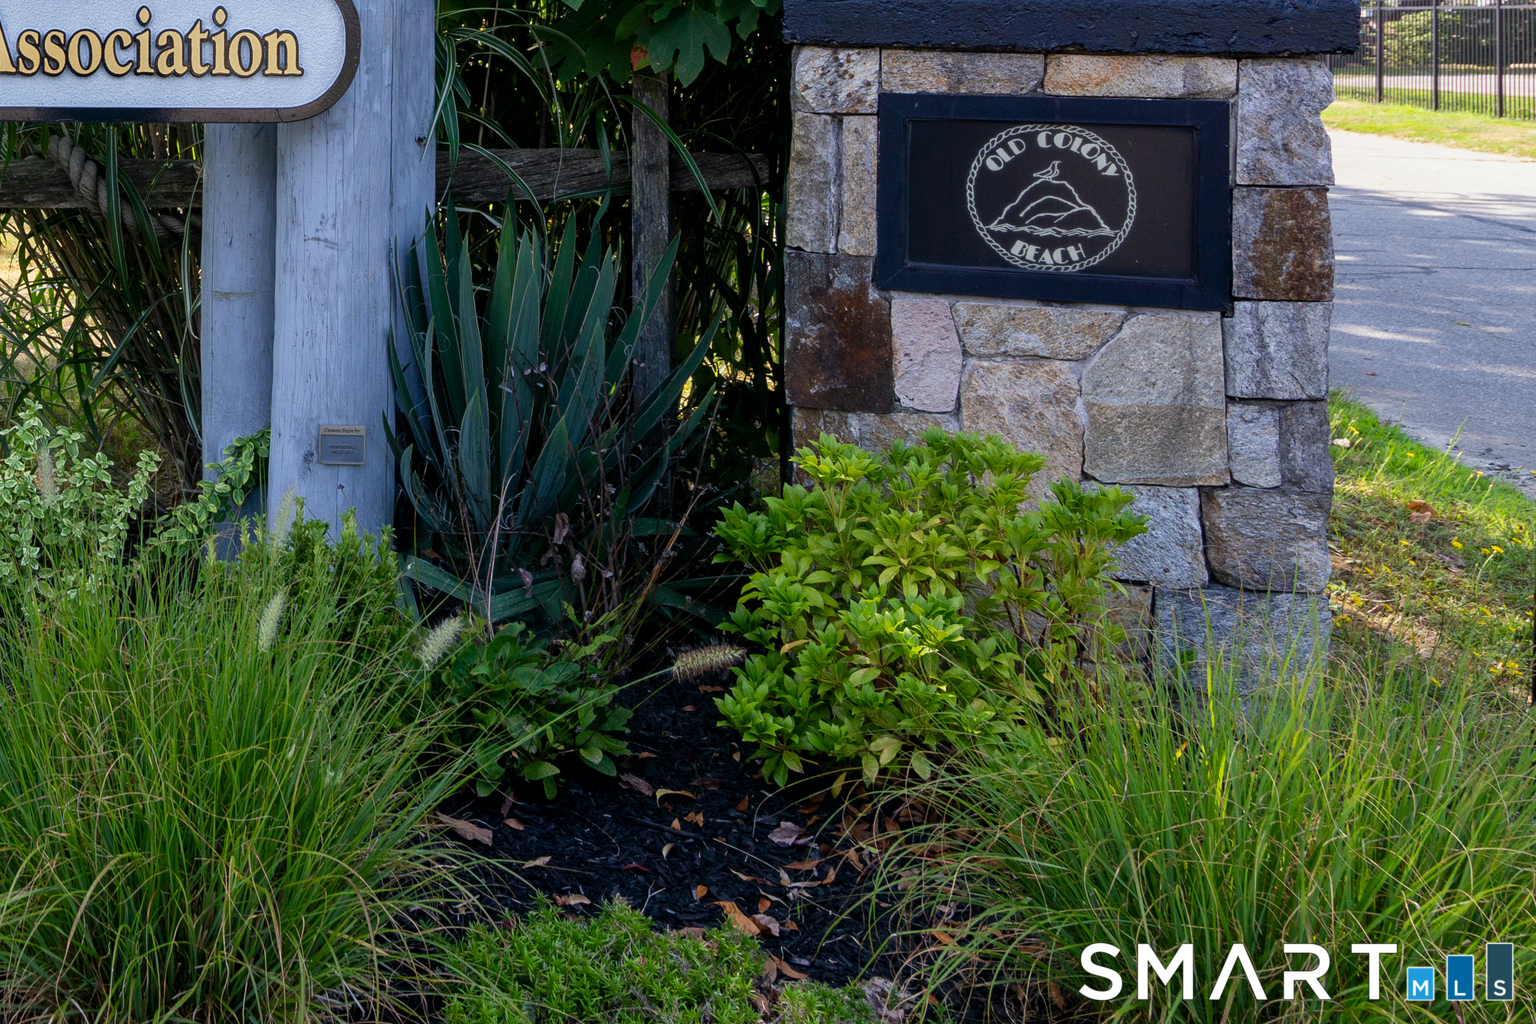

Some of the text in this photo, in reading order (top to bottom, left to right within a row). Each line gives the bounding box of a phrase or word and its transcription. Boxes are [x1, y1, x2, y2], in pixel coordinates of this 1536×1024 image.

[985, 131, 1120, 176] OLD COLONY
[1010, 239, 1086, 265] BEACH
